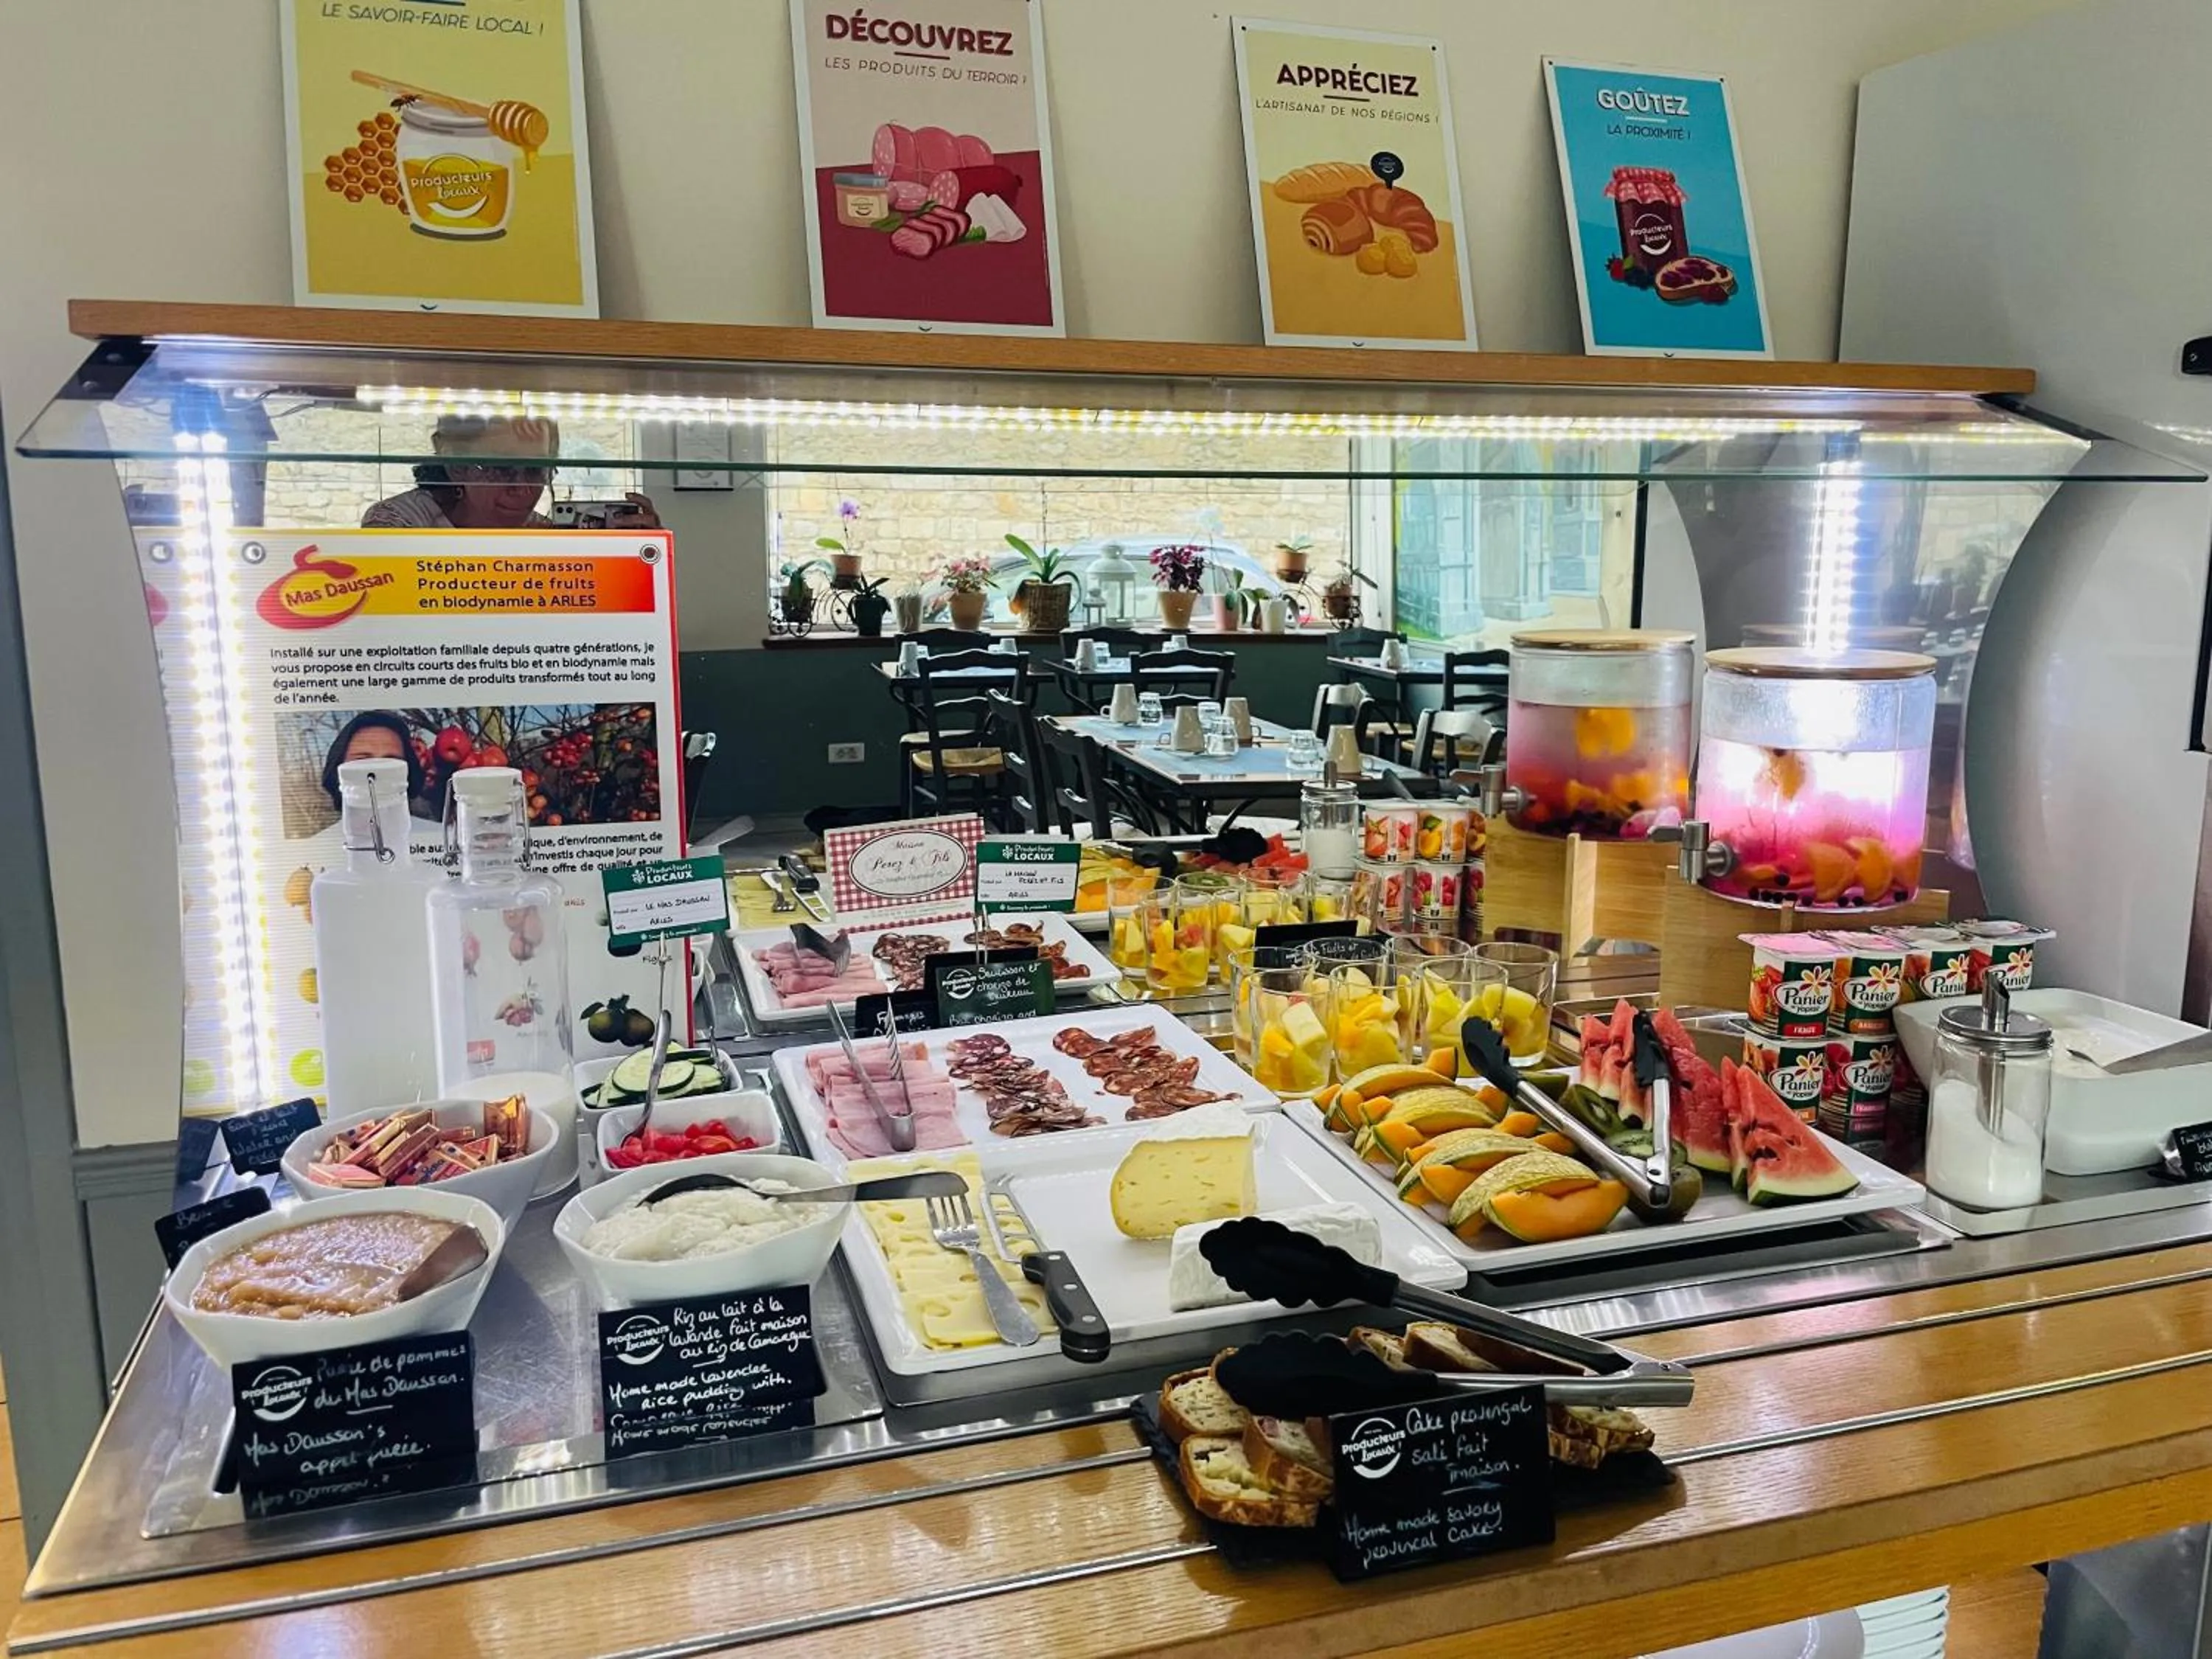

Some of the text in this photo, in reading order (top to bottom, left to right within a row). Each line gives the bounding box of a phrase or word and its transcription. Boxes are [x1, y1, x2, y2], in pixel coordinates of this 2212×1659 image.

[322, 4, 344, 18] LE
[349, 5, 470, 28] SAVOIR-FAIRE
[476, 17, 532, 35] LOCAL
[826, 9, 1014, 55] DÉCOUVREZ
[825, 57, 1018, 85] LES PRODUITS DU TERROIR
[1277, 63, 1419, 97] APPRÉCIEZ
[1256, 99, 1430, 123] L'ARTISANAT DE NOS RÉGIONS
[1598, 87, 1690, 116] GOÛTEZ
[1607, 125, 1684, 140] LA PROXIMITÉ
[417, 560, 594, 574] Stéphan Charmasson
[286, 572, 394, 607] Mas Daussan
[418, 577, 595, 590] Producteur de fruits
[420, 595, 597, 611] en biodynamie à ARLES
[271, 642, 655, 658] Installé sur une exploitation familiale depuis quatre générations, je
[271, 656, 655, 675] vous propose en circuits courts des fruits bio et en biodynamie mais
[274, 670, 656, 691] également une large gamme de produits transformés tout au long
[274, 692, 340, 704] de l'année.
[557, 831, 664, 846] d'environnement, de
[576, 846, 614, 859] chaque
[616, 846, 636, 858] jour
[639, 846, 664, 858] pour
[553, 863, 577, 874] offre
[581, 861, 594, 872] de
[647, 870, 695, 884] LOCAUX
[1782, 987, 1829, 1006] Panier
[1849, 982, 1897, 1004] Panier
[1778, 1072, 1821, 1091] Panier
[674, 1295, 784, 1332] Riz au lait à la
[730, 1318, 757, 1336] fait
[760, 1314, 807, 1332] maison
[680, 1345, 703, 1359] au
[729, 1338, 748, 1352] de
[748, 1329, 812, 1353] Camargue
[371, 1354, 394, 1374] de
[397, 1344, 467, 1373] pommes
[346, 1378, 378, 1408] Mas
[609, 1381, 652, 1408] Home
[654, 1375, 698, 1391] made
[683, 1383, 745, 1408] pudding
[1405, 1407, 1444, 1436] Cake
[244, 1431, 279, 1467] Mas
[1344, 1512, 1391, 1549] Home
[1397, 1509, 1440, 1532] made
